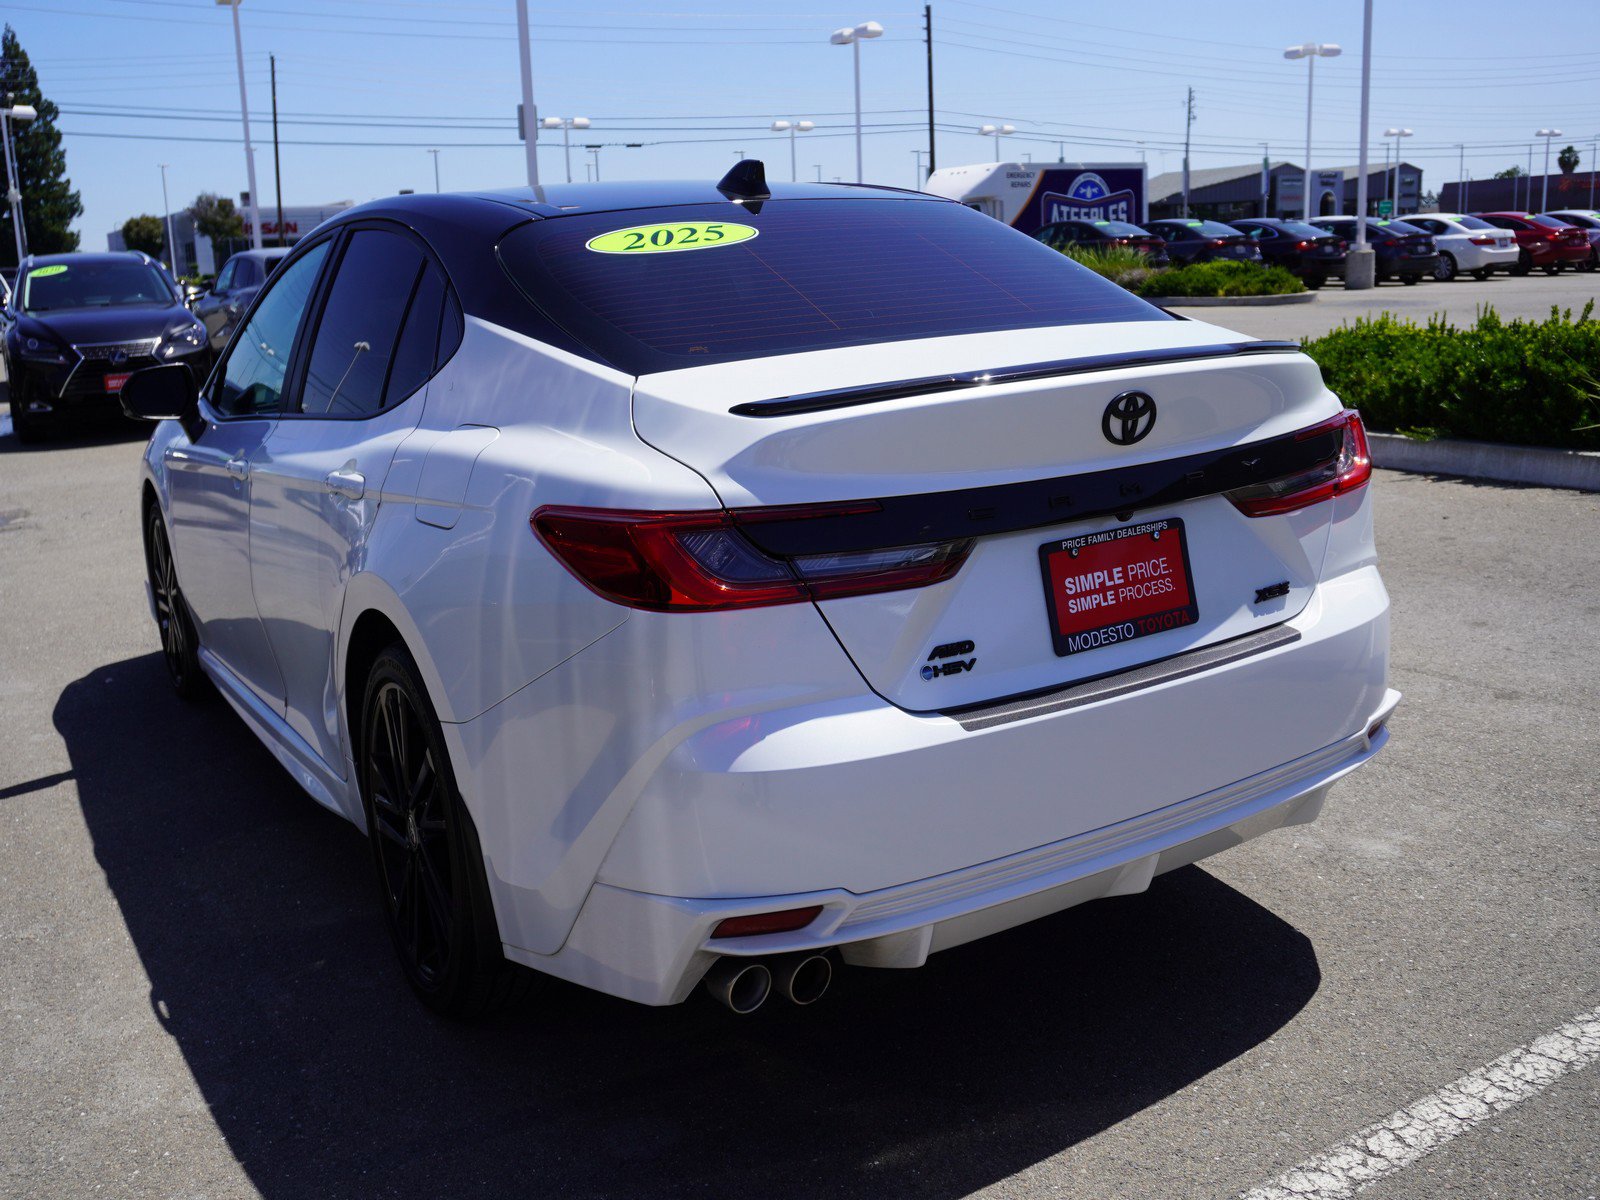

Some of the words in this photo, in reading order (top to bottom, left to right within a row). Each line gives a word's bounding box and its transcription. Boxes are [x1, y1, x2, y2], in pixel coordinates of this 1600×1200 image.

[623, 225, 724, 251] 2025
[1062, 540, 1086, 550] PRICE
[1088, 532, 1115, 545] FAMILY
[1117, 521, 1168, 539] DEALERSHIPS
[1064, 567, 1125, 595] SIMPLE
[1128, 557, 1173, 579] PRICE.
[1068, 590, 1116, 614] SIMPLE
[1119, 578, 1176, 602] PROCESS.
[1068, 623, 1135, 652] MODESTO
[1138, 611, 1191, 634] TOYOTA
[932, 657, 977, 678] HEV
